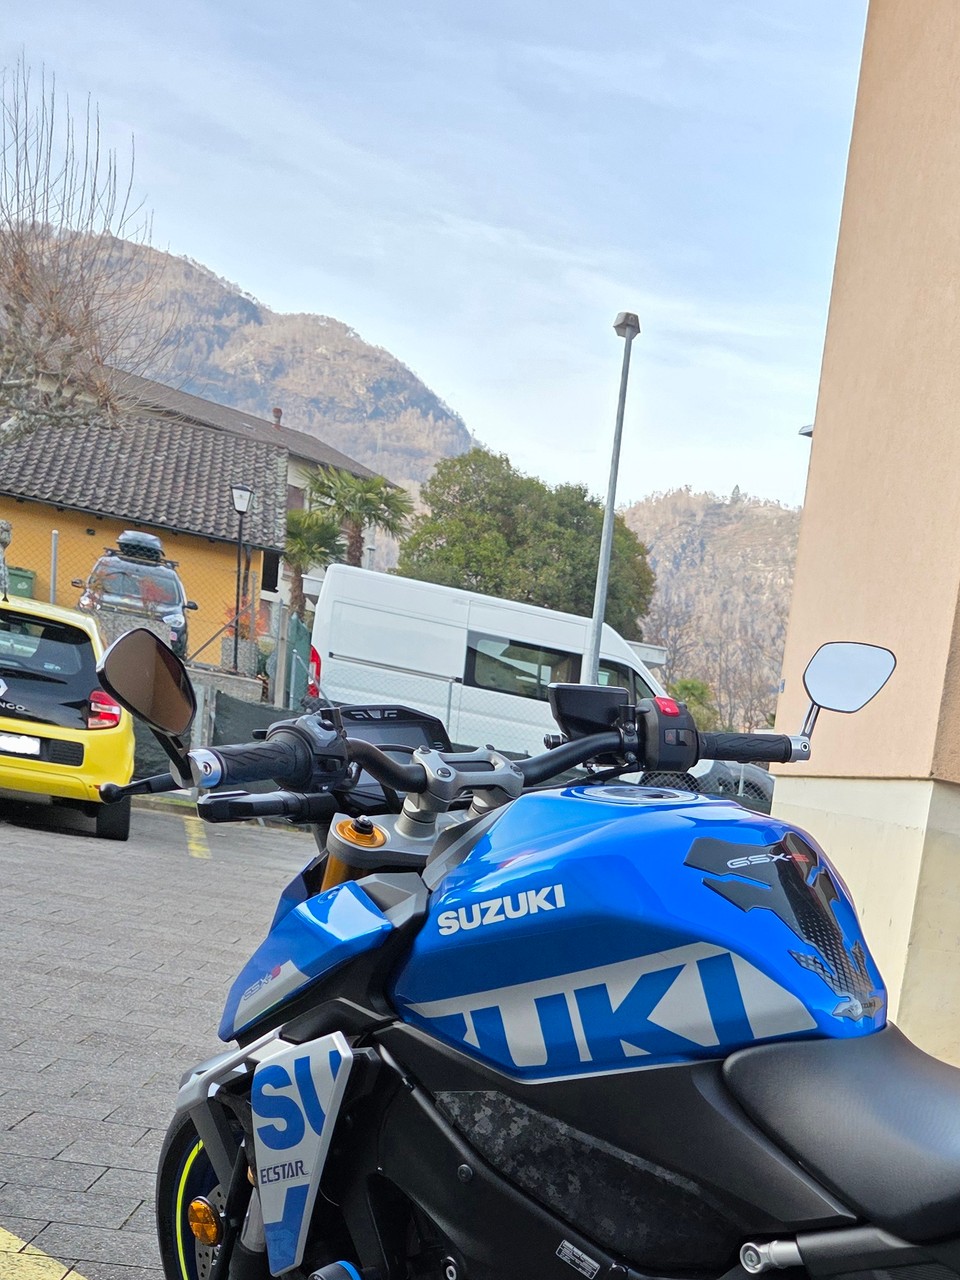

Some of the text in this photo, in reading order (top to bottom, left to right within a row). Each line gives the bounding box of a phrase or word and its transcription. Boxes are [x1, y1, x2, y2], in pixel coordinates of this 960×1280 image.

[727, 853, 809, 868] GSX-S
[437, 884, 566, 936] SUZUKI
[260, 1160, 308, 1184] ECSTAR
